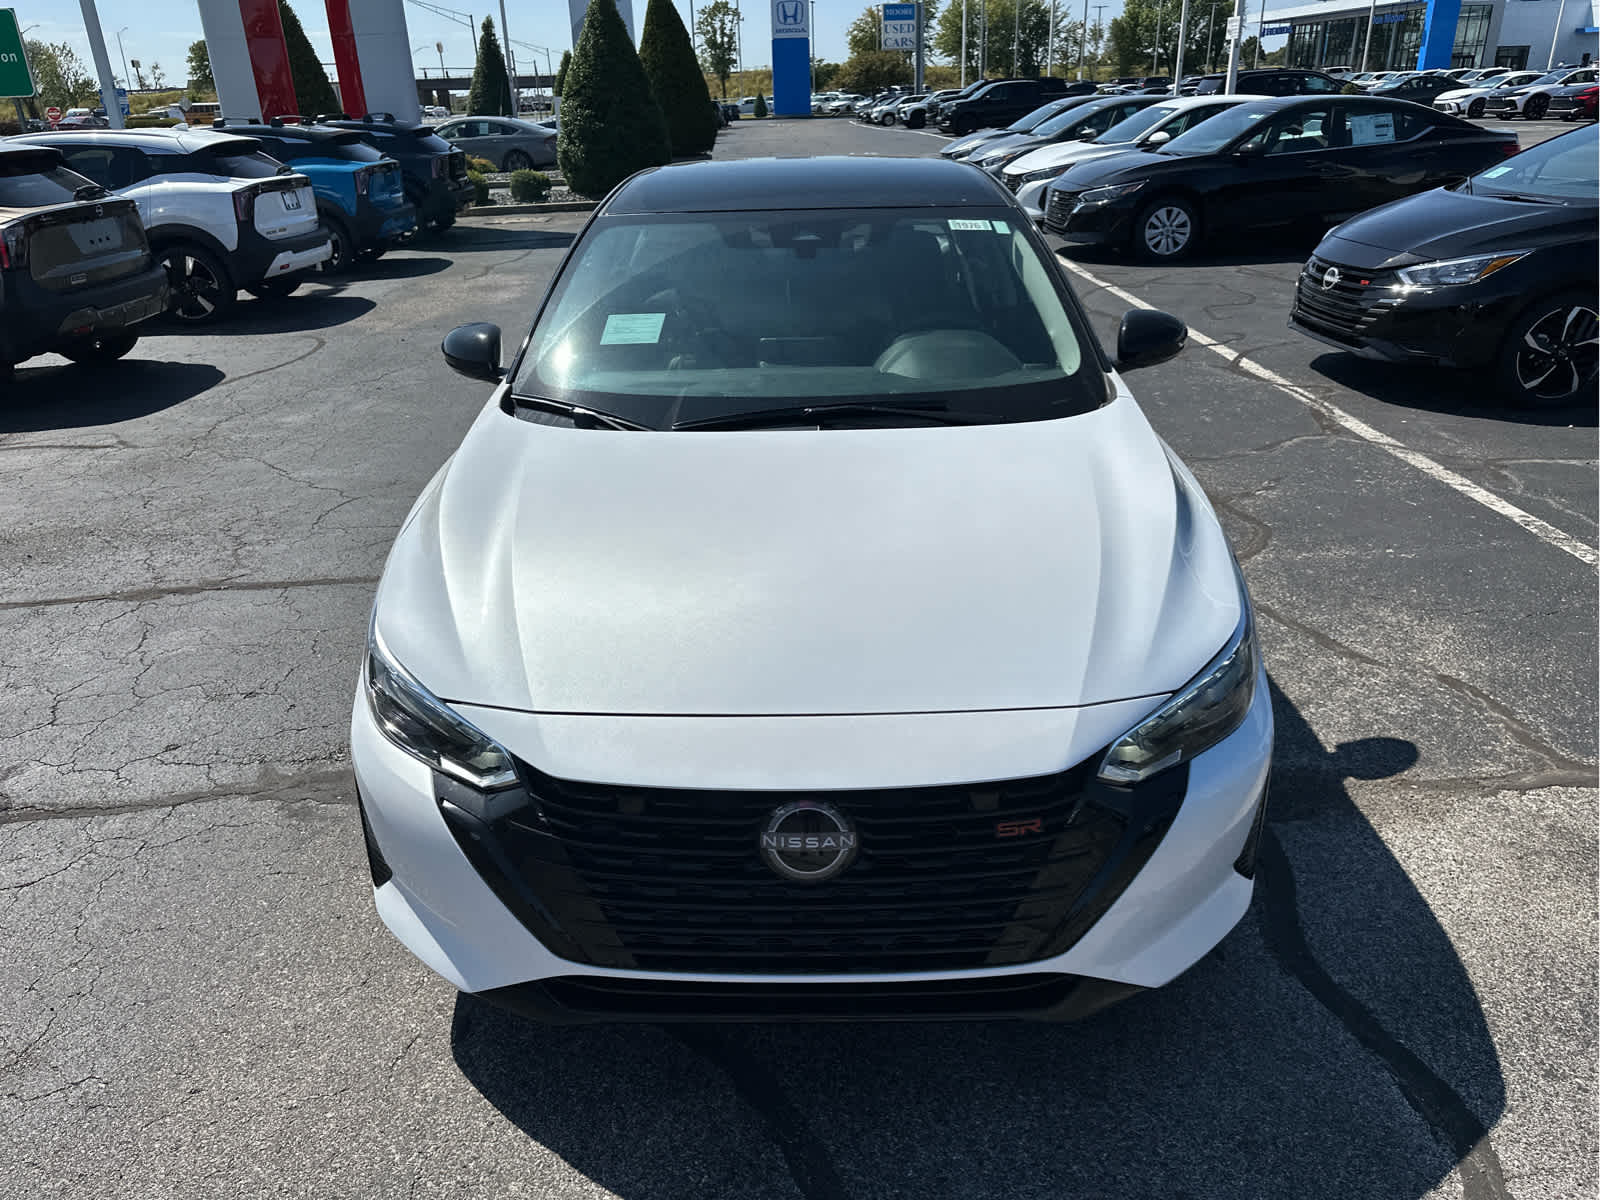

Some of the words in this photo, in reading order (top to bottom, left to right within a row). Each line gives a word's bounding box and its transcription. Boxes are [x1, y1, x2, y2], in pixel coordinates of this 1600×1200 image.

[884, 23, 915, 34] USED
[884, 37, 914, 48] CARS
[996, 818, 1042, 838] SR
[762, 834, 855, 850] NISSAN
